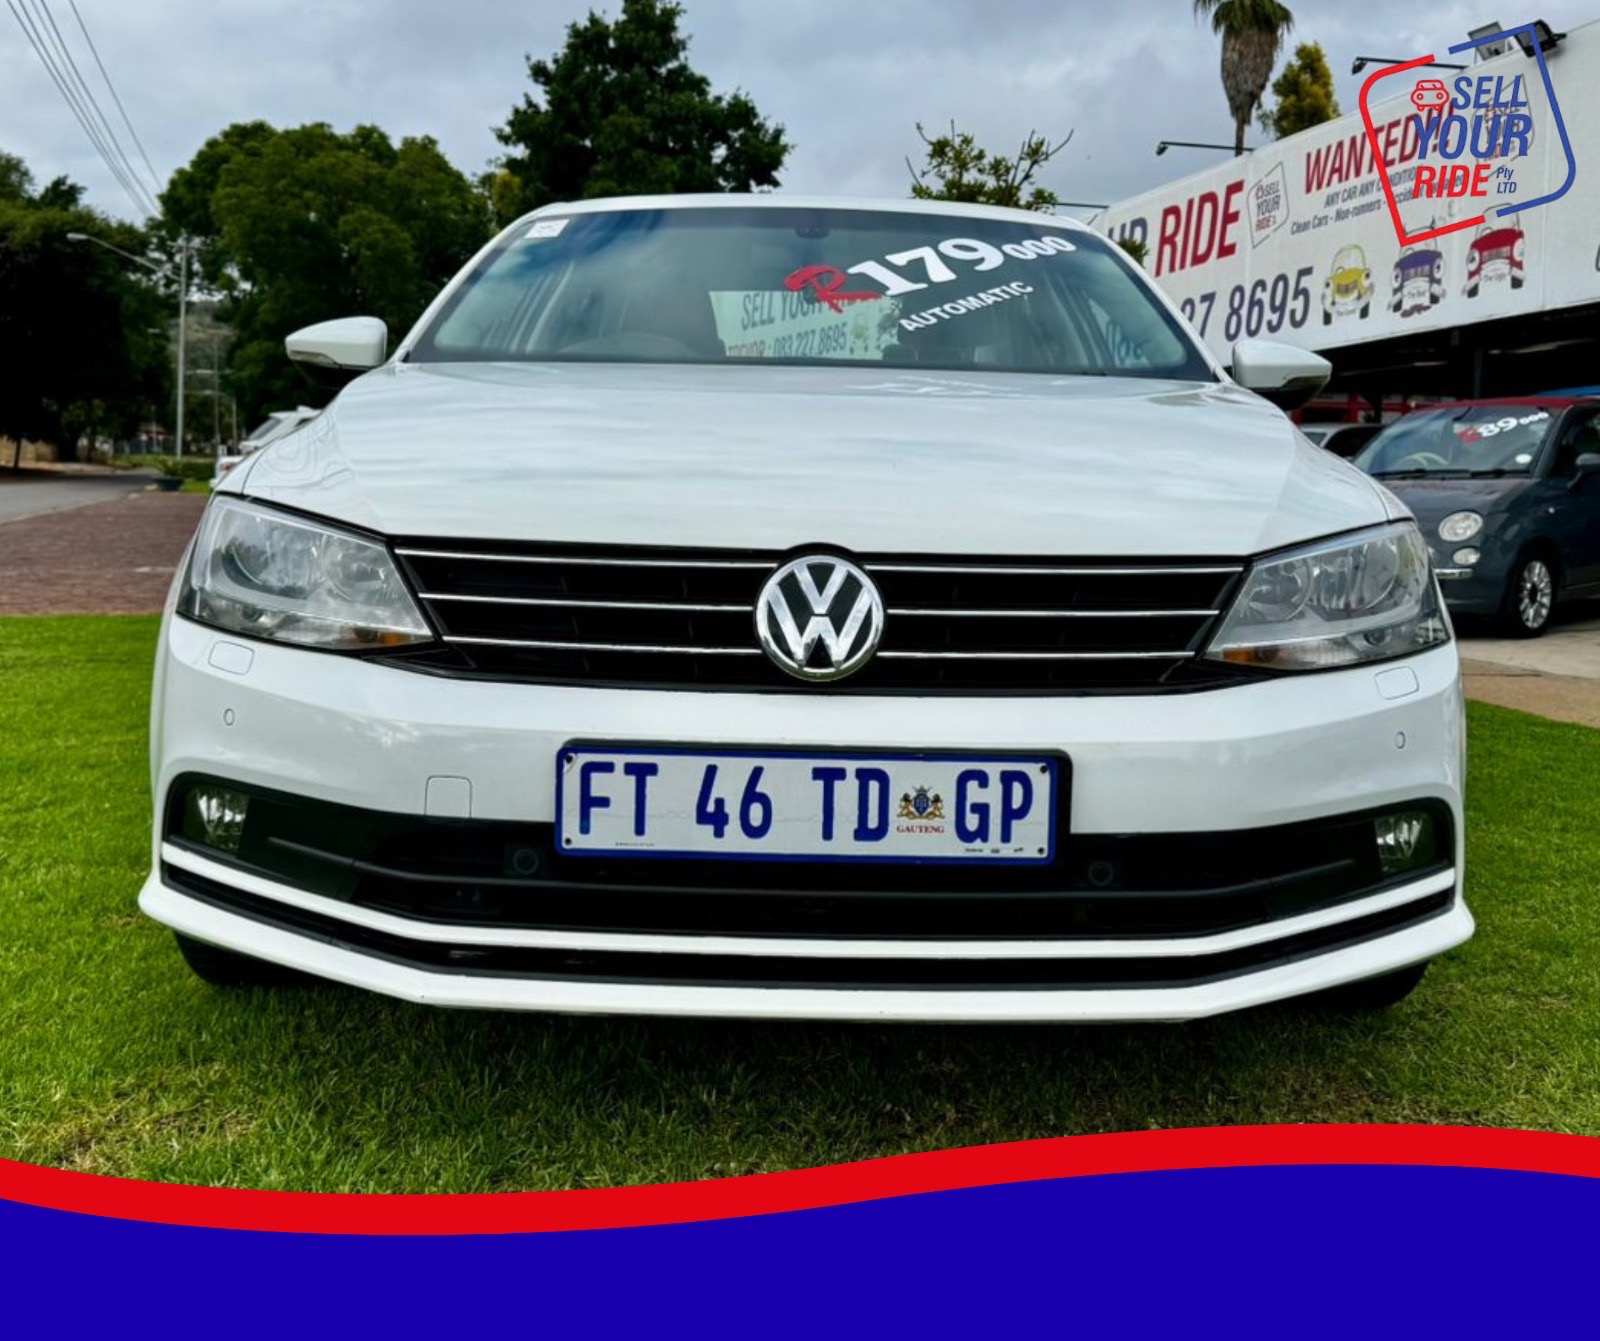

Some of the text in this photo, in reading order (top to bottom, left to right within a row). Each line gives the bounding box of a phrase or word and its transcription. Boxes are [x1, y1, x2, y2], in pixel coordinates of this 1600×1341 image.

[1341, 186, 1358, 203] CAR
[1359, 179, 1376, 197] ANY
[1154, 179, 1245, 278] RIDE
[1312, 214, 1329, 229] Cars
[741, 290, 775, 332] SELL
[899, 280, 1035, 332] AUTOMATIC
[1225, 266, 1313, 342] 8695
[578, 760, 1034, 845] FT 46 TD GP
[896, 824, 945, 834] GAUTENG
